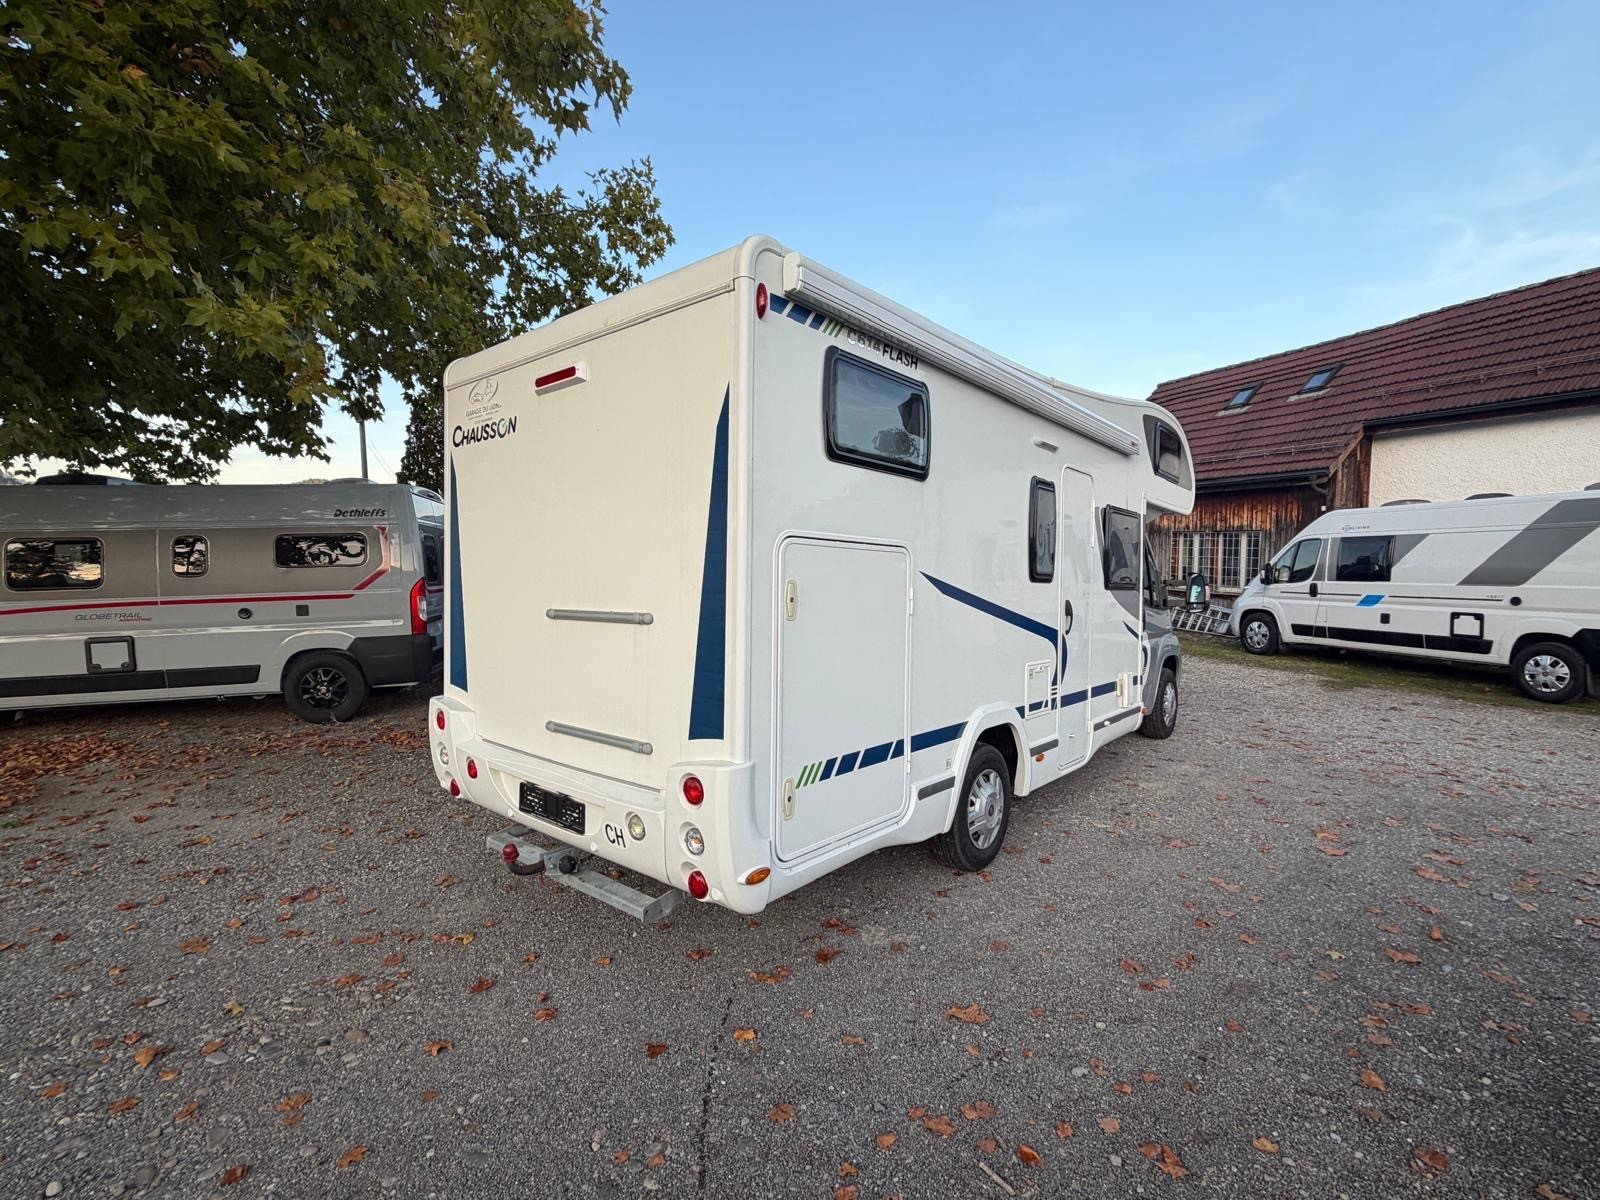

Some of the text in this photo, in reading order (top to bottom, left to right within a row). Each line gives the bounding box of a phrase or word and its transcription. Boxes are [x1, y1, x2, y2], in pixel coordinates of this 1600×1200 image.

[882, 343, 919, 370] FLASH
[453, 416, 517, 448] CHAUSSON
[333, 508, 386, 517] Dethleffs
[75, 612, 142, 621] GLOBETRAIL
[605, 823, 626, 849] CH
